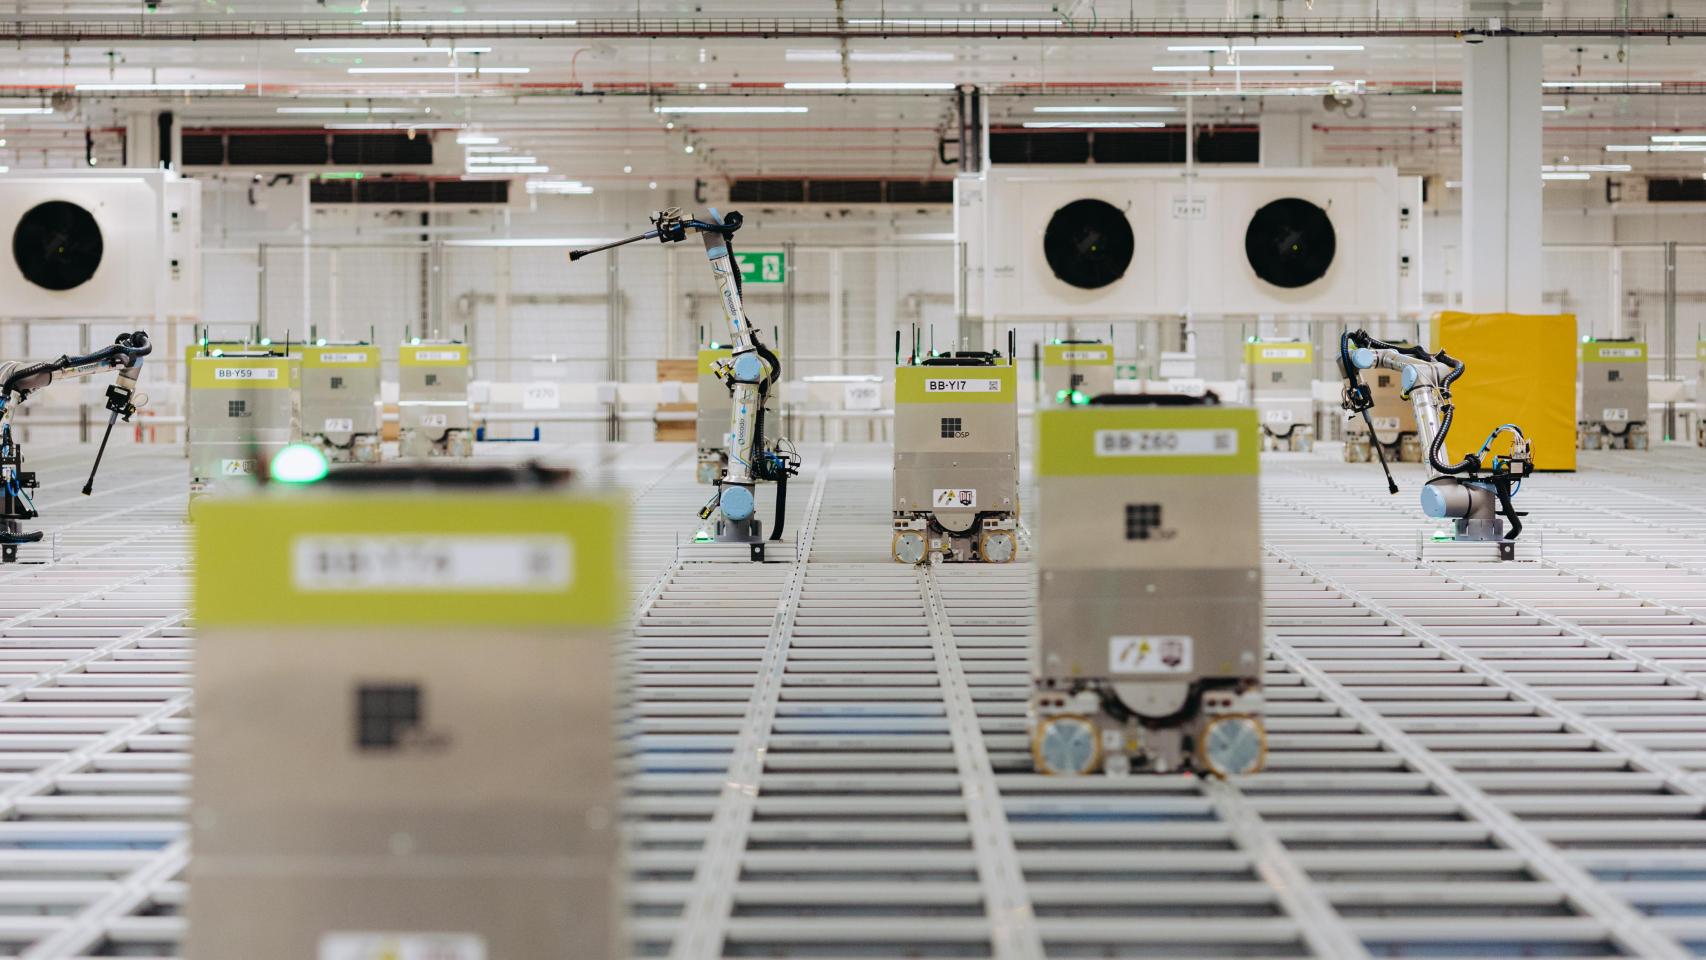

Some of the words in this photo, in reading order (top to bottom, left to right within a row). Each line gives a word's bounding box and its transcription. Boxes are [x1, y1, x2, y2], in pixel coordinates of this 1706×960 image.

[218, 369, 253, 378] BB-Y59
[929, 381, 967, 391] BB-Y17
[1103, 432, 1178, 451] BB-Z60
